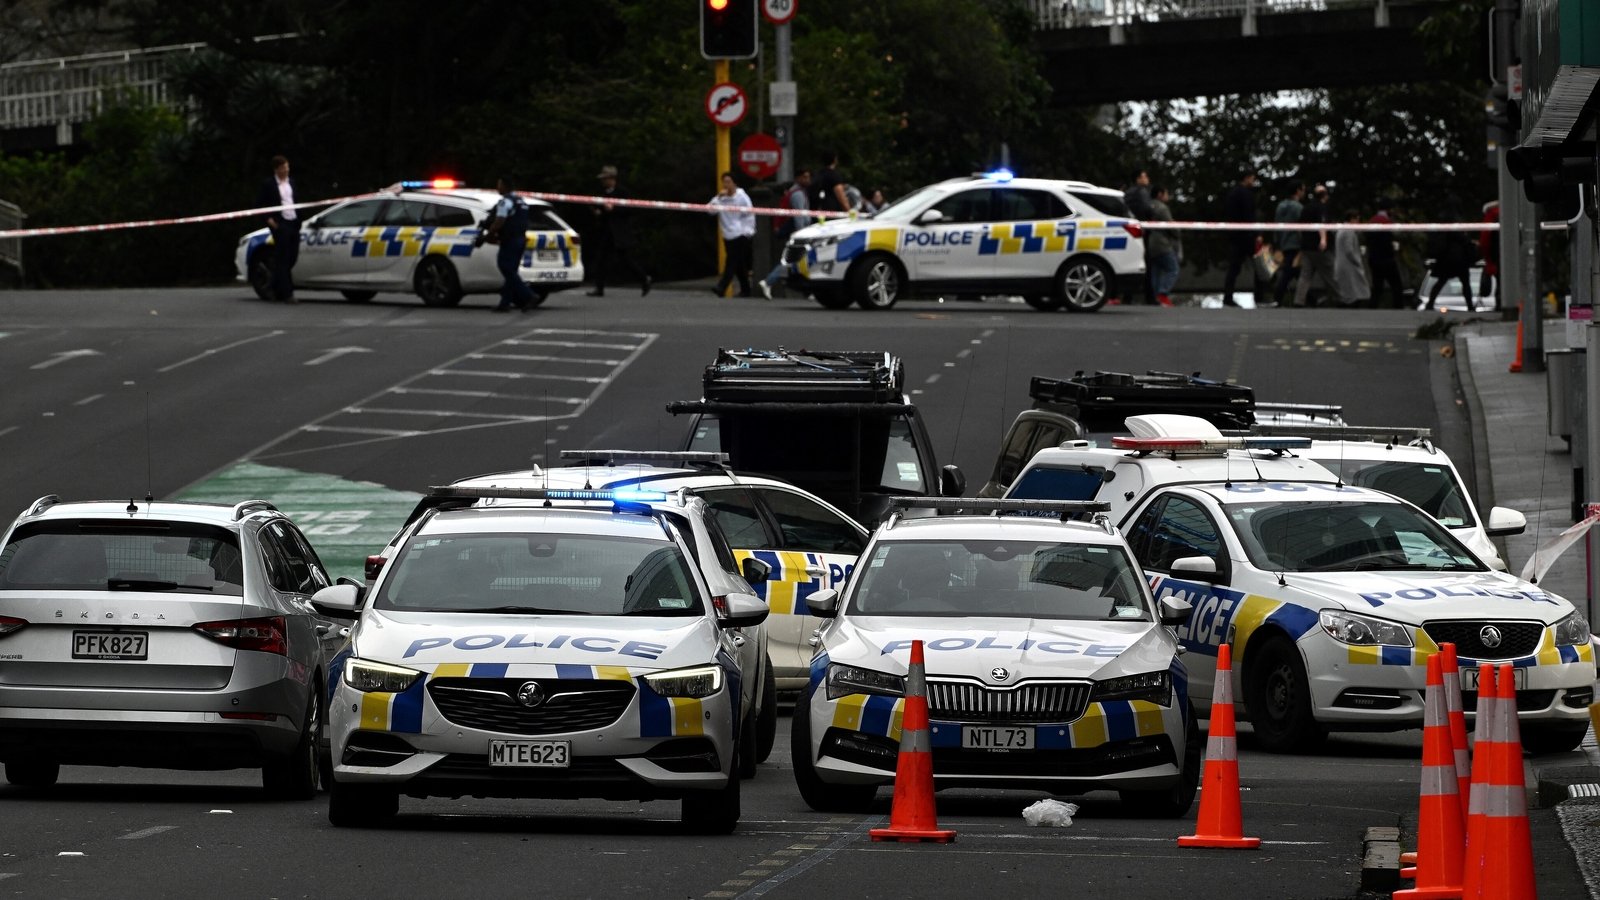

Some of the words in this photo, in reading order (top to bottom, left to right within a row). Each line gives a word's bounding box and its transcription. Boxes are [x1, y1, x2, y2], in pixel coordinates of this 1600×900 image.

[769, 0, 790, 11] 40
[300, 231, 351, 246] POLICE
[904, 231, 973, 246] POLICE
[538, 271, 568, 279] POLICE
[1359, 586, 1560, 608] POLICE
[75, 635, 145, 655] PFK827
[402, 634, 668, 661] POLICE
[881, 637, 1127, 658] POLICE
[970, 729, 1027, 748] NTL73
[492, 744, 567, 764] MTE623
